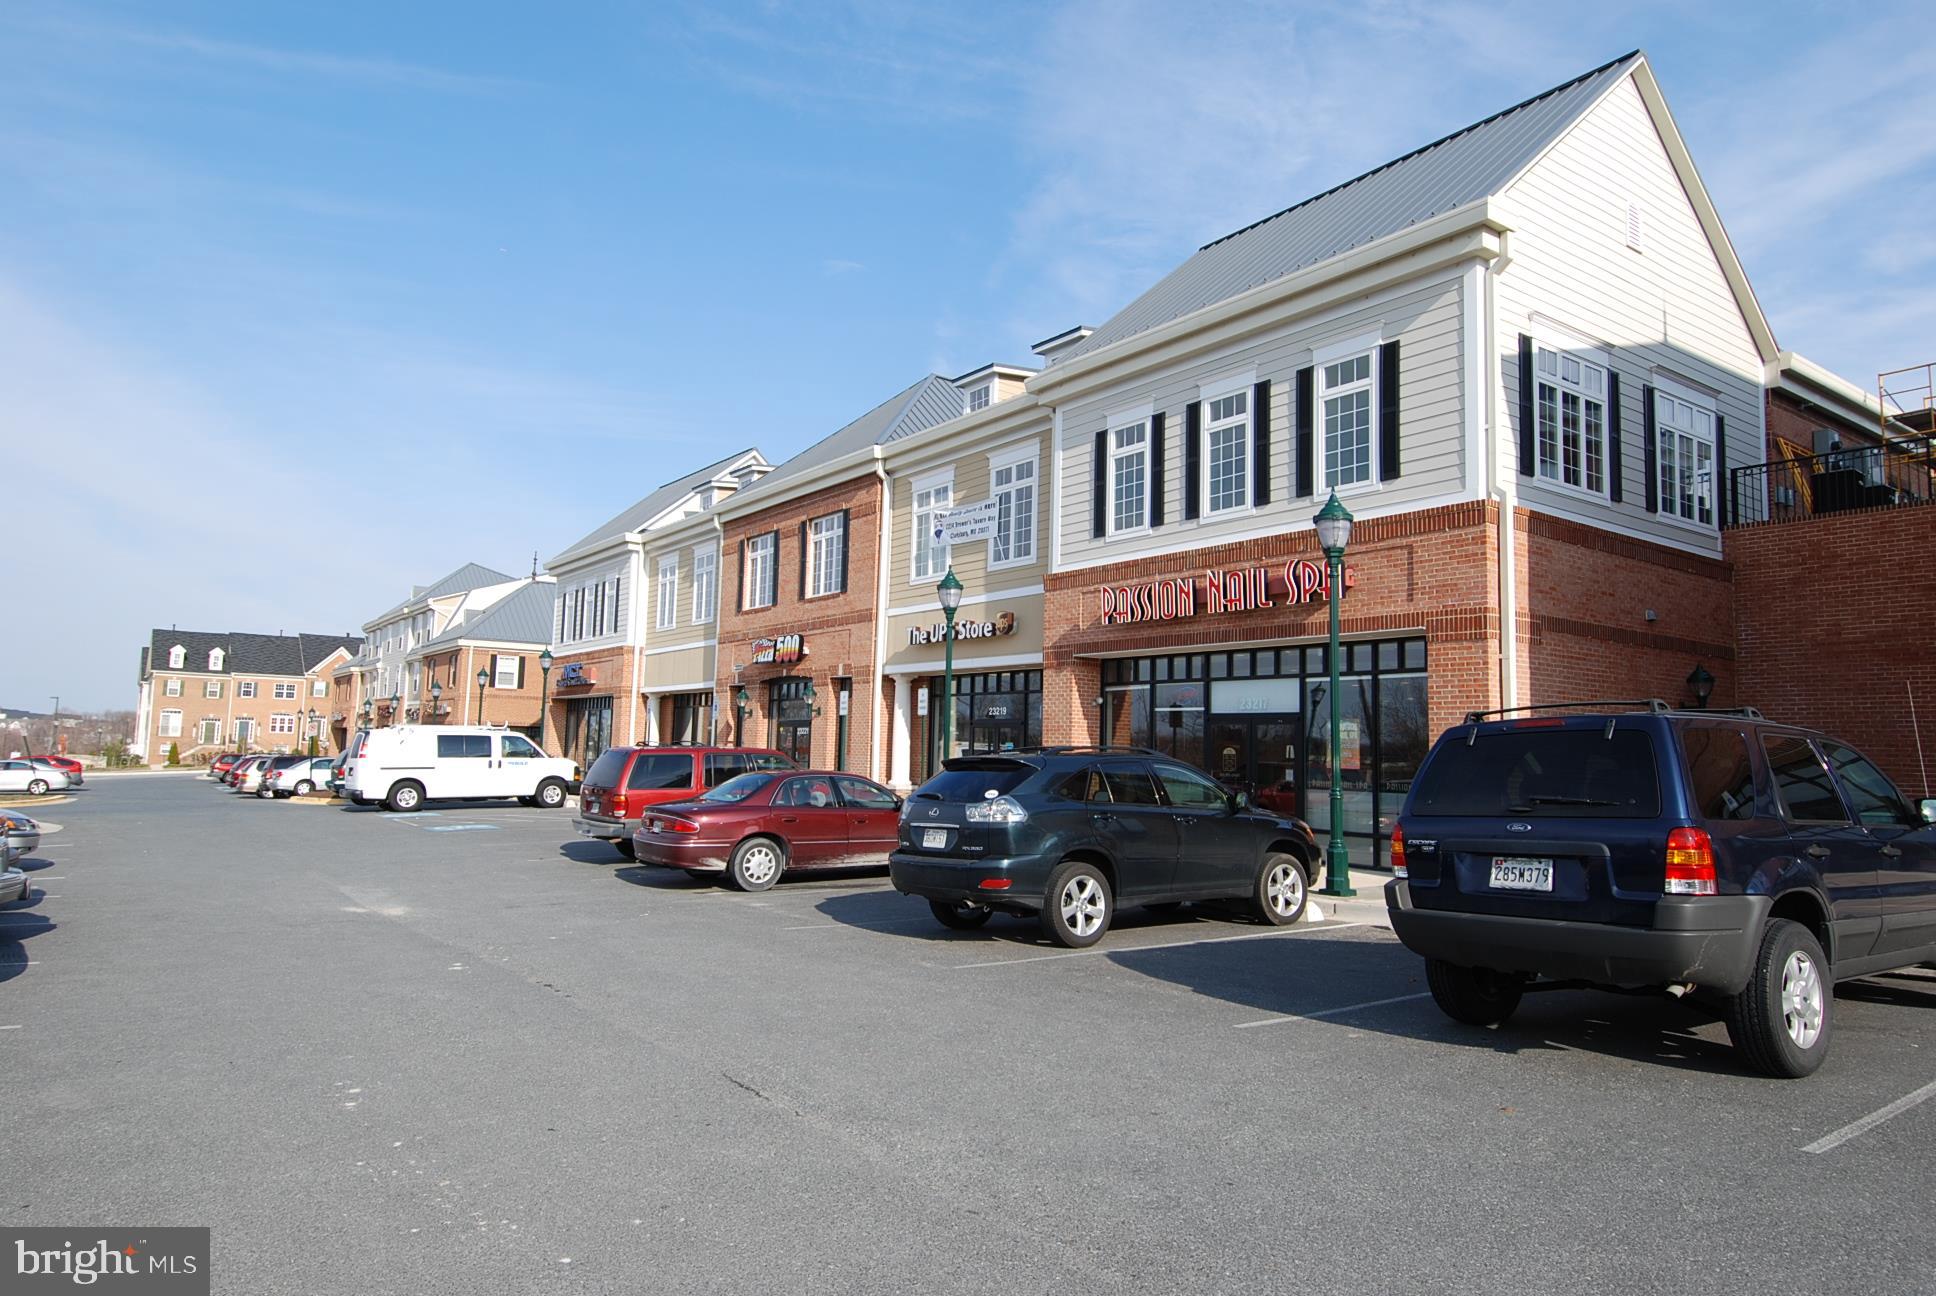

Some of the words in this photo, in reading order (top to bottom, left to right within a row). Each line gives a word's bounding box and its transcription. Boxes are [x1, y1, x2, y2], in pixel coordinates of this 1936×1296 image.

[1101, 577, 1194, 625] PASSION
[1207, 569, 1273, 613] NAIL
[907, 627, 927, 645] The
[930, 624, 955, 643] UP
[958, 620, 992, 640] Store
[775, 634, 800, 664] 500
[988, 706, 1007, 716] 23219
[1494, 865, 1550, 884] 285M379
